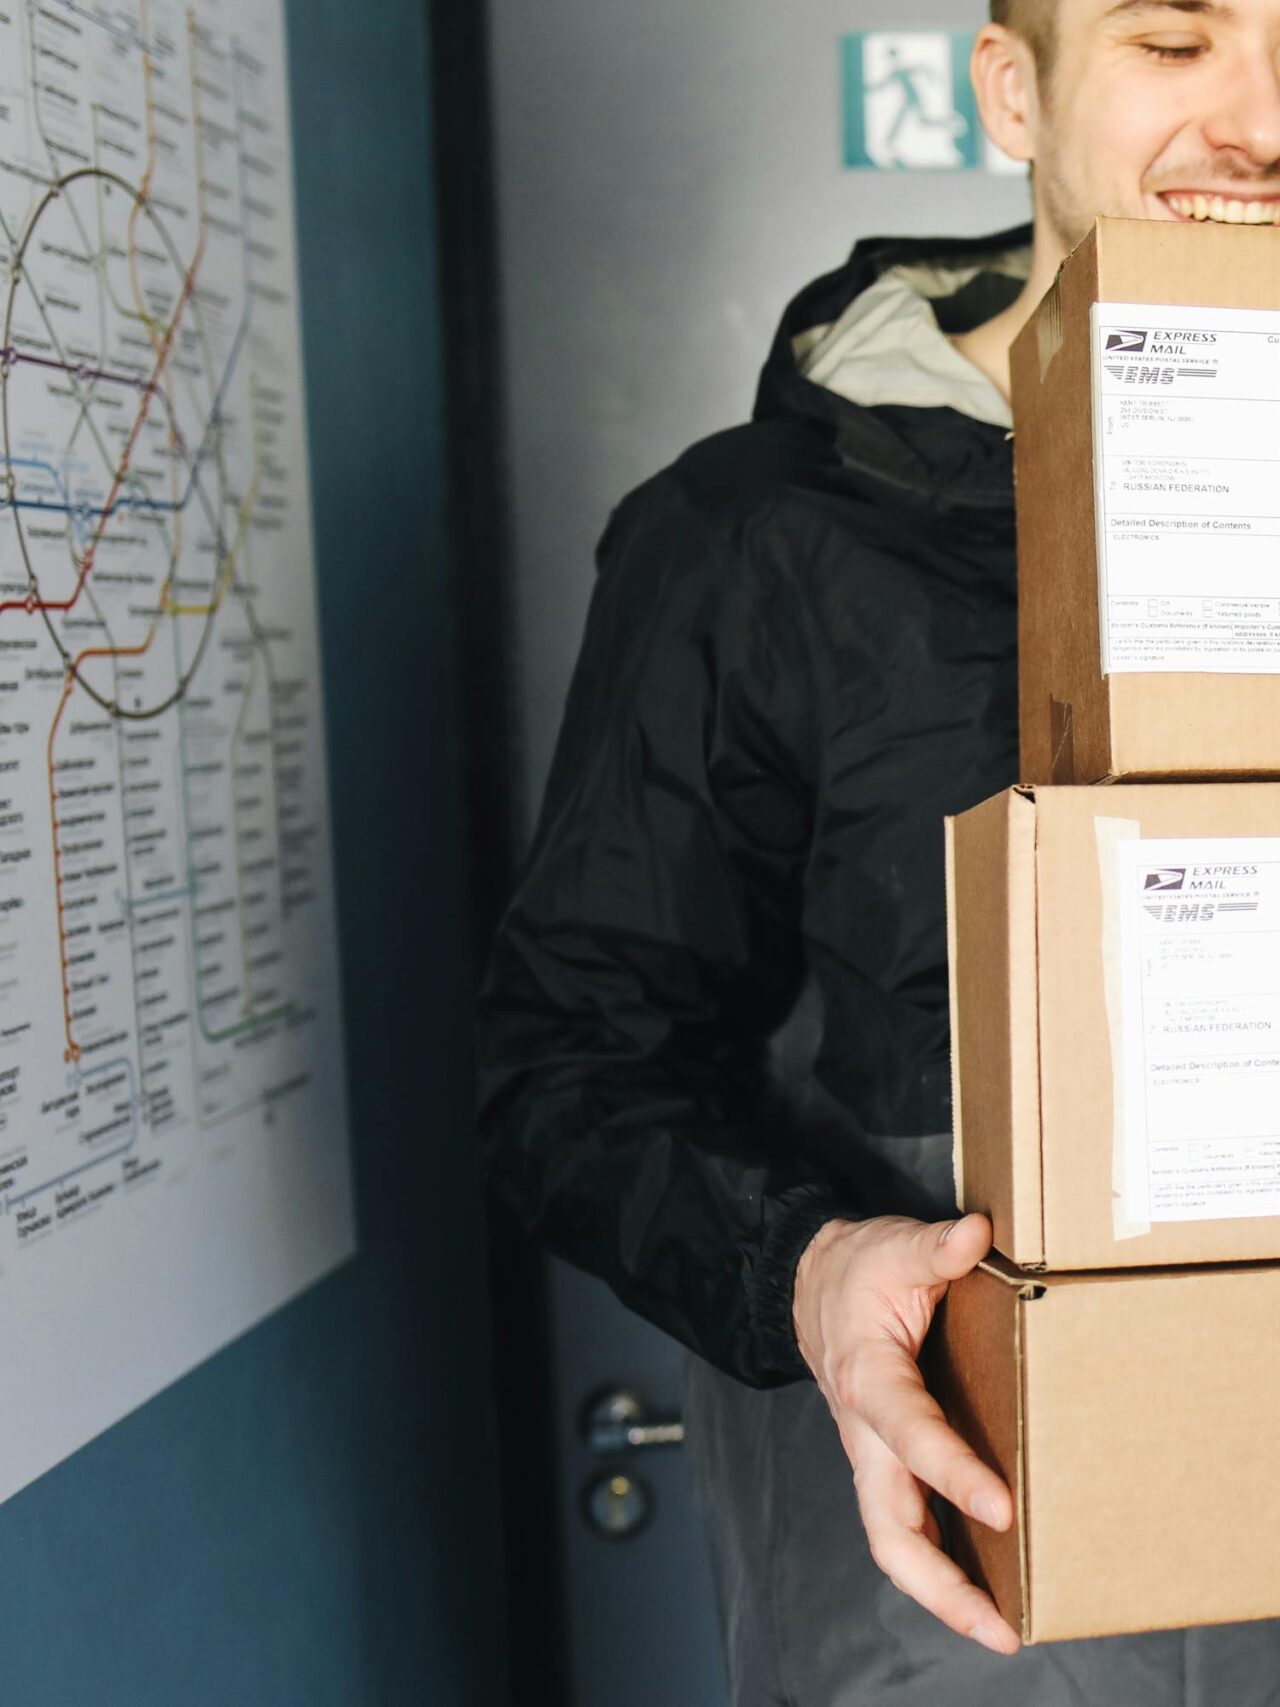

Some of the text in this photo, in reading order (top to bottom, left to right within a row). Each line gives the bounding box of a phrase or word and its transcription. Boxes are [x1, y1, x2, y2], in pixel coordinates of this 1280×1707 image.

[1153, 331, 1217, 343] EXPRESS
[1150, 344, 1186, 354] MAIL
[1124, 366, 1176, 384] EMS
[1124, 482, 1229, 493] RUSSIAN FEDERATION
[1111, 519, 1146, 527] Detailed
[1149, 520, 1198, 529] Description
[1212, 521, 1251, 530] Contents
[1192, 865, 1258, 876] EXPRESS
[1190, 880, 1226, 890] MAIL
[1164, 904, 1215, 922] EMS
[1164, 1024, 1207, 1033] RUSSIAN
[1209, 1022, 1272, 1032] FEDERATION
[1151, 1063, 1186, 1072] Detailed
[1189, 1061, 1240, 1071] Description
[1243, 1060, 1251, 1068] of
